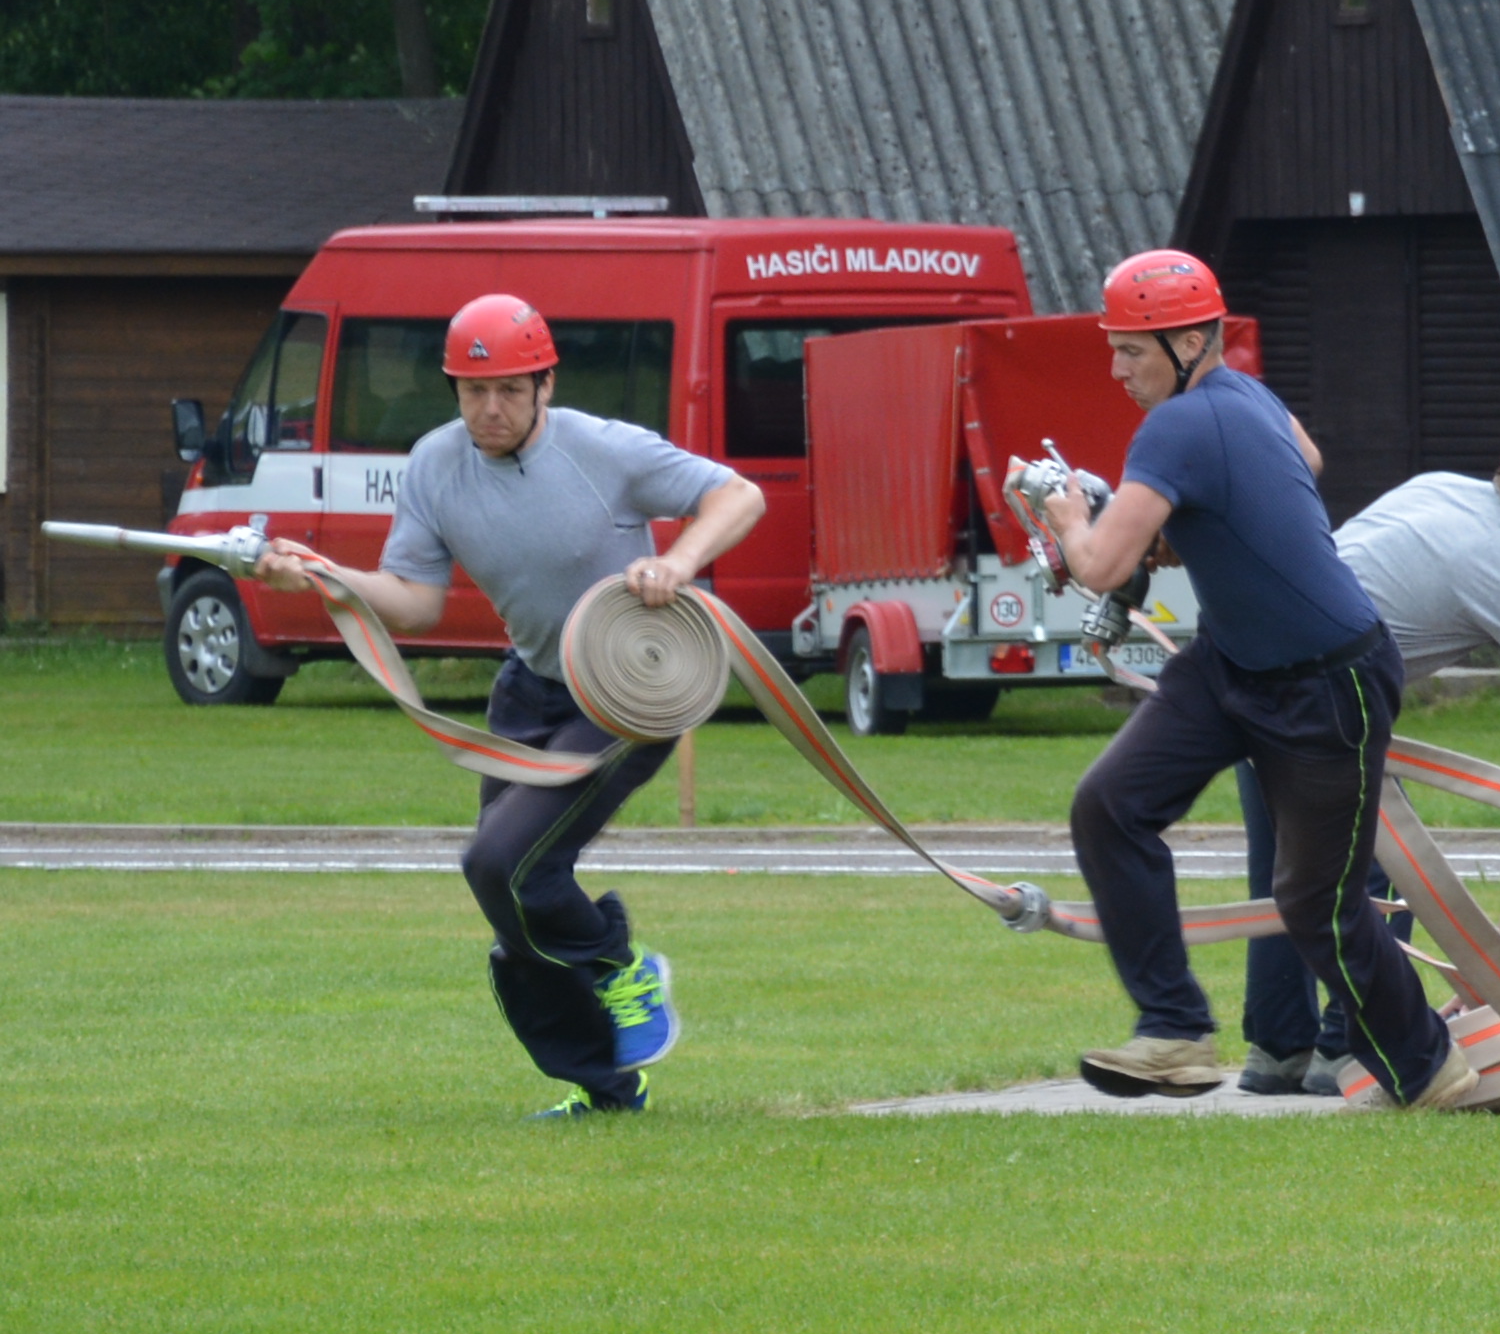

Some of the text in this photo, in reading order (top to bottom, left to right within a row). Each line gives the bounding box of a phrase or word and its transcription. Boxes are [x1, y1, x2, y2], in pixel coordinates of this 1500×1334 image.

[746, 243, 980, 280] HASIČI MLADKOV
[365, 469, 403, 504] HA
[997, 600, 1019, 618] 130
